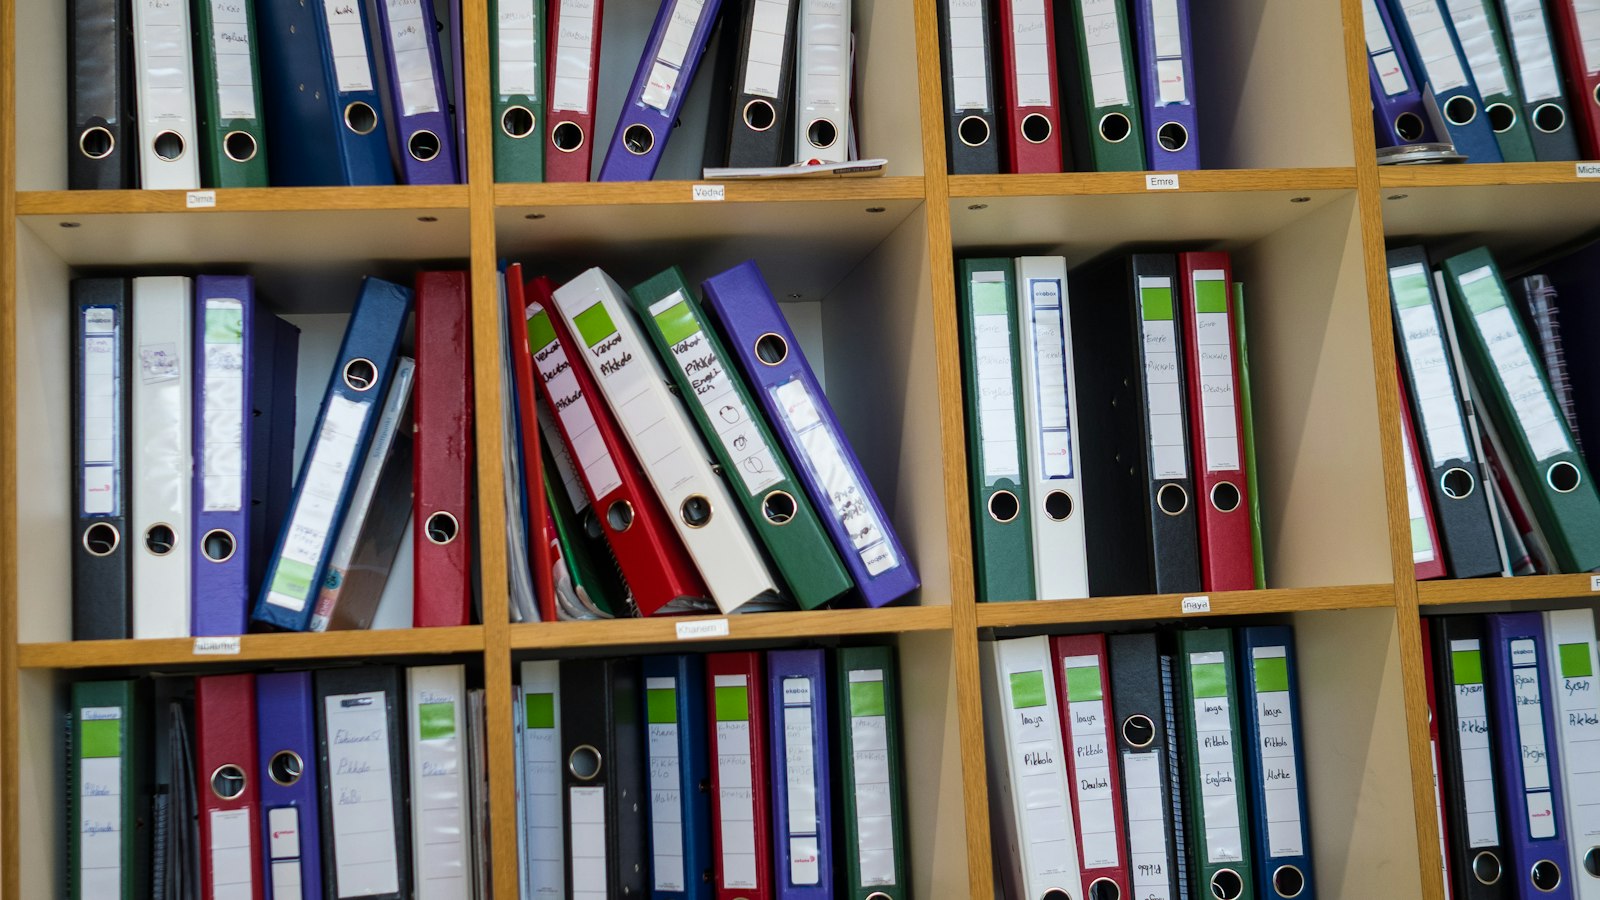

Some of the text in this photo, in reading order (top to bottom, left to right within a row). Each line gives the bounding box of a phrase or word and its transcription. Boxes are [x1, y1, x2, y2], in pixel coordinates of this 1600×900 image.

[1151, 177, 1174, 186] Emre
[694, 187, 724, 197] Vedad
[1076, 743, 1104, 757] Pikkolo
[1081, 777, 1108, 791] Deutsch
[1205, 770, 1232, 787] Englisch
